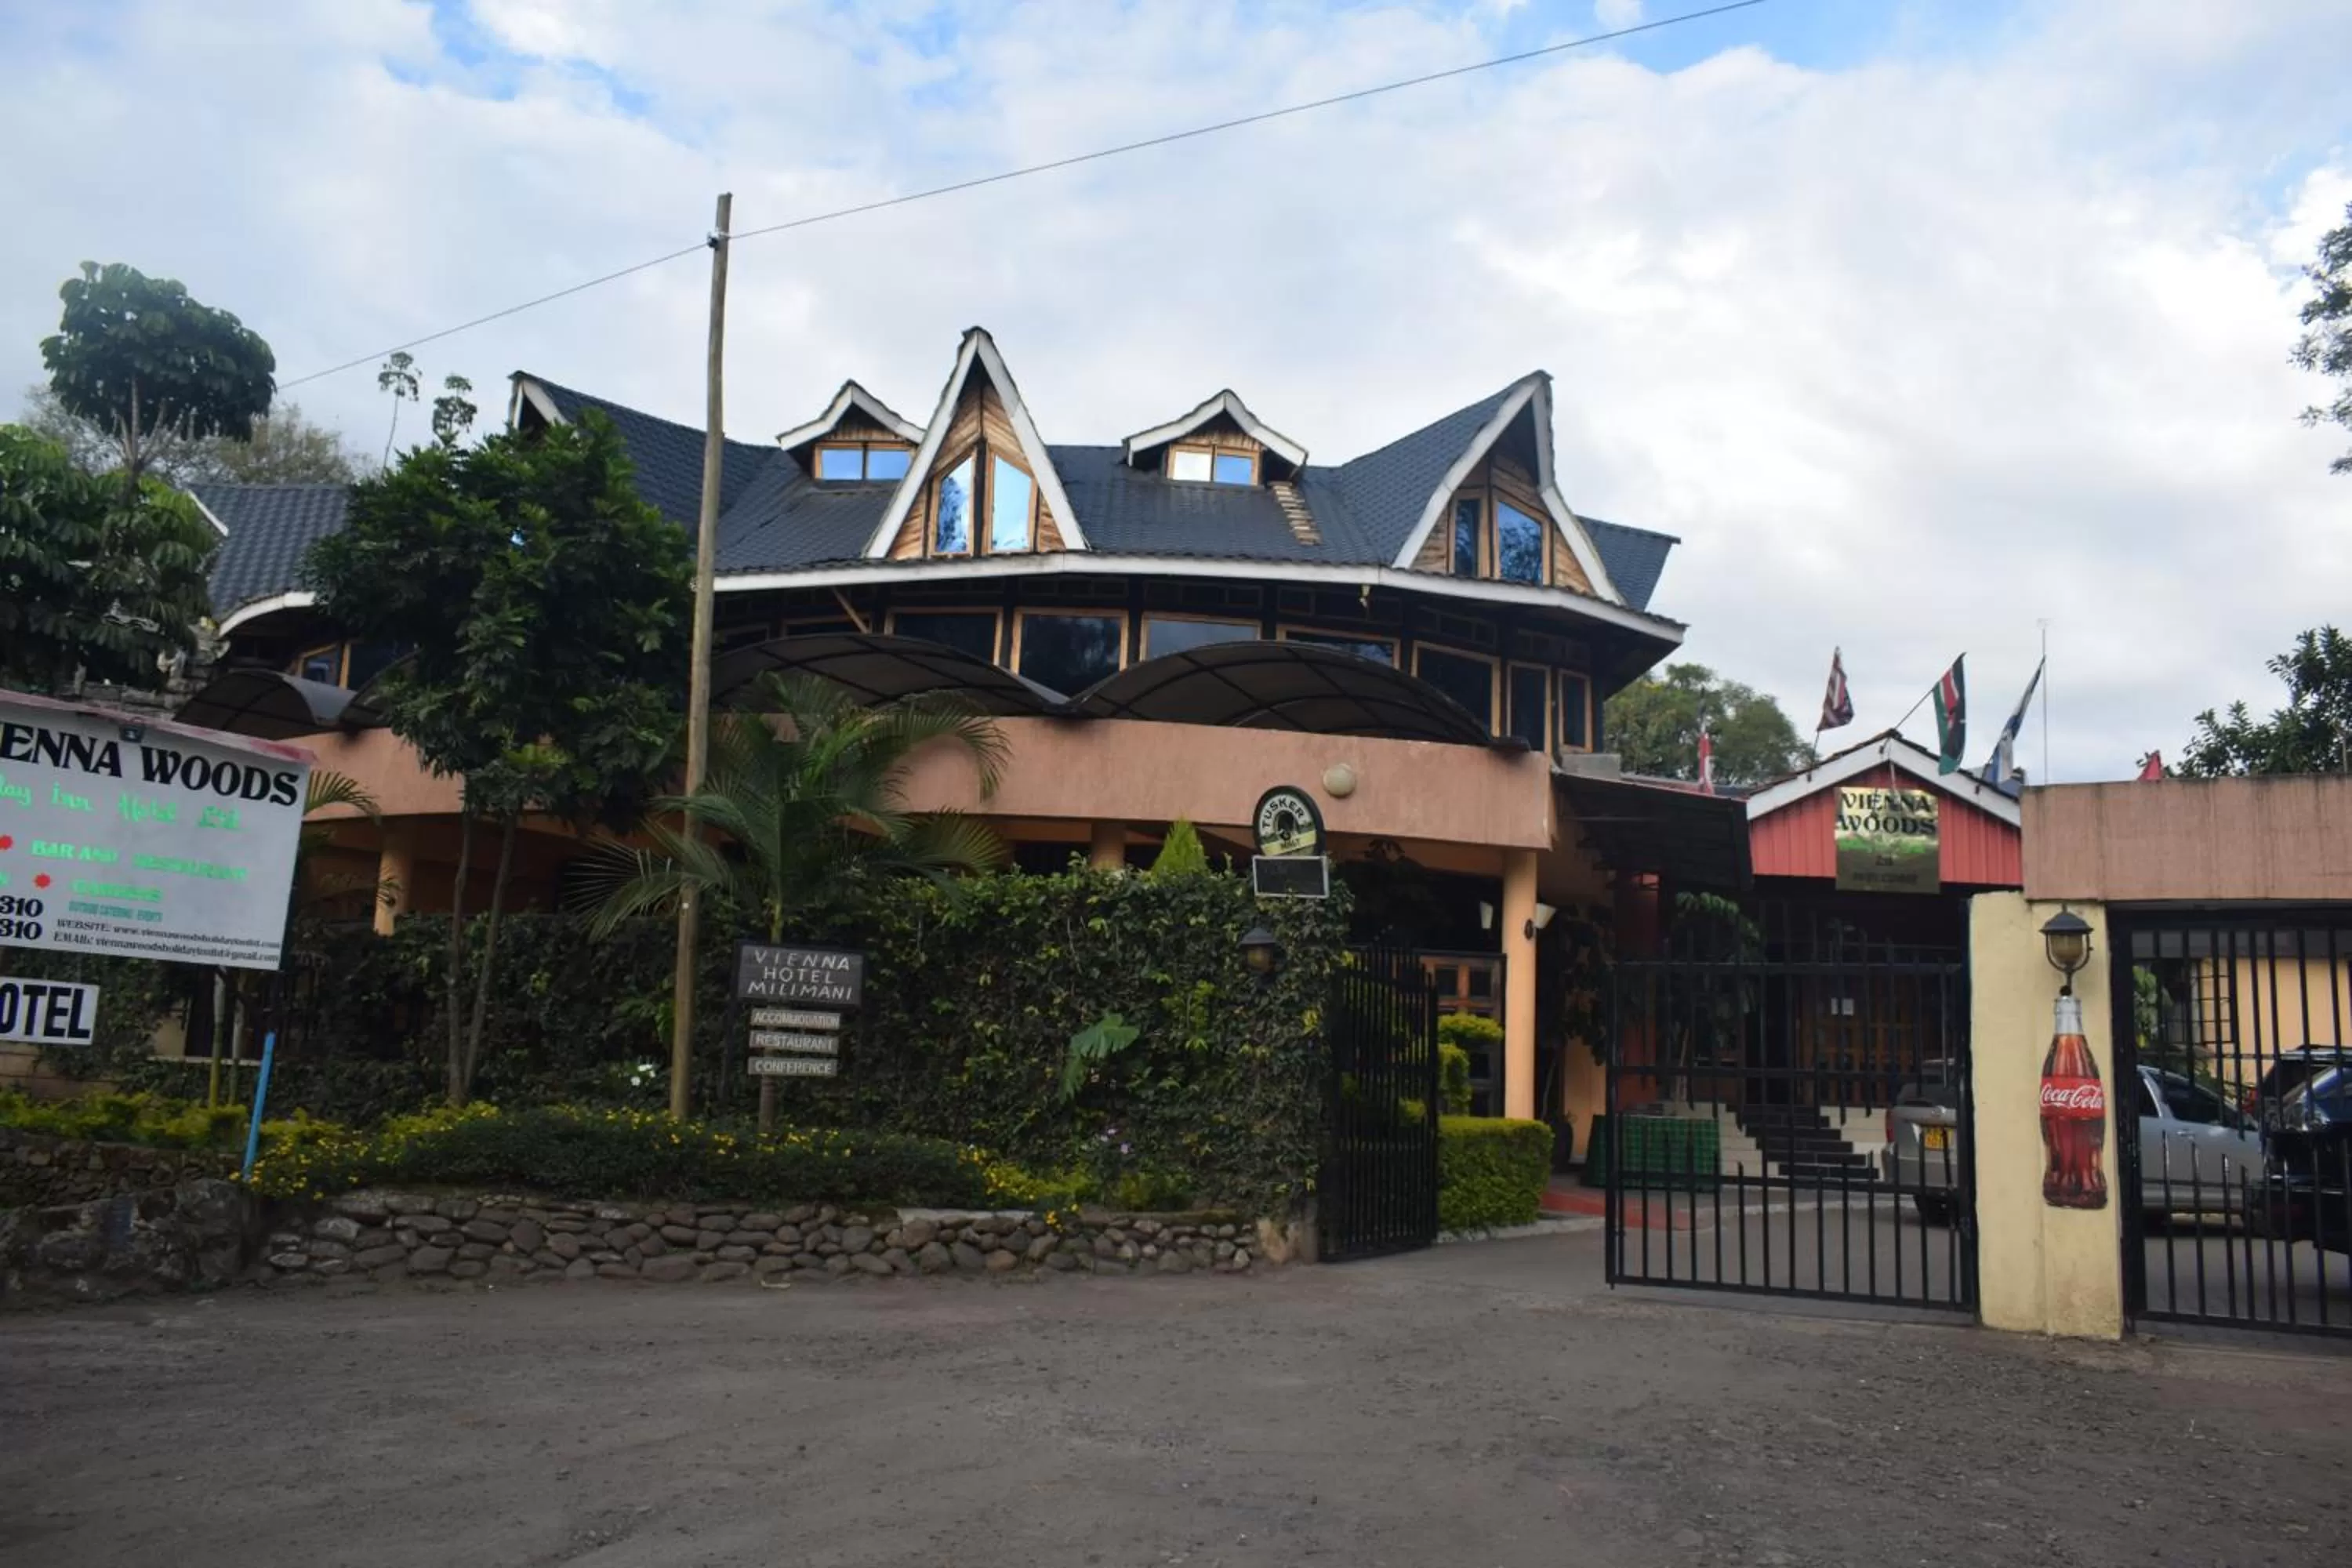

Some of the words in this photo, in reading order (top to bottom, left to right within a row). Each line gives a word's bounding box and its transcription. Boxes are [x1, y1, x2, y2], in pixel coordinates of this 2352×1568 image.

[140, 746, 299, 807] WOODS
[1262, 797, 1305, 829] TUSKER
[1842, 793, 1932, 813] VIENNA
[1835, 813, 1937, 837] WOODS
[31, 840, 74, 859] BAR
[754, 949, 849, 971] VIENNA
[763, 966, 834, 984] HOTEL
[747, 982, 852, 1000] MILIMANI
[755, 1034, 833, 1051] RESTAURANT
[755, 1060, 832, 1075] CONFERENCE
[2040, 1083, 2102, 1109] Coca-Cola
